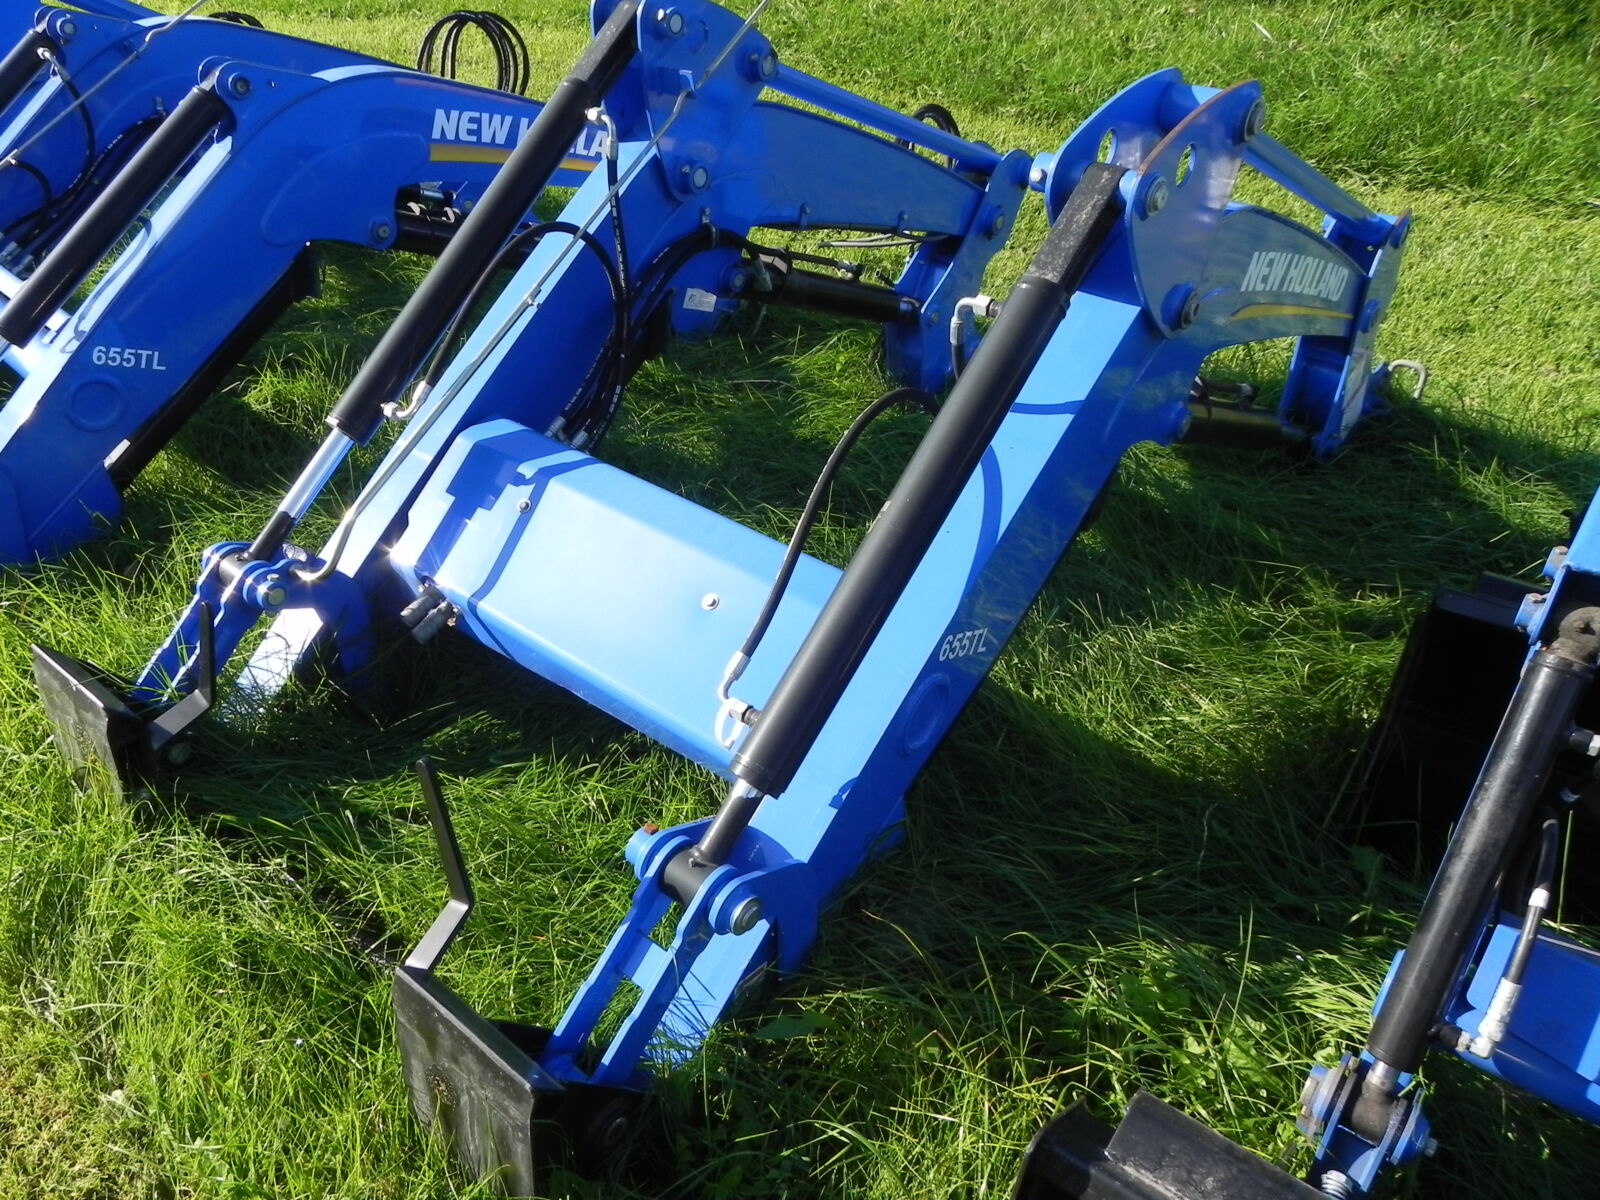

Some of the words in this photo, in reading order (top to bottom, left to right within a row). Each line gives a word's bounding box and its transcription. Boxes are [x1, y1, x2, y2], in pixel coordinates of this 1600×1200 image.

[431, 108, 513, 145] NEW
[1240, 251, 1292, 292] NEW
[1282, 254, 1349, 302] HOLLAND
[92, 345, 166, 370] 655TL
[938, 627, 988, 661] 655TL
